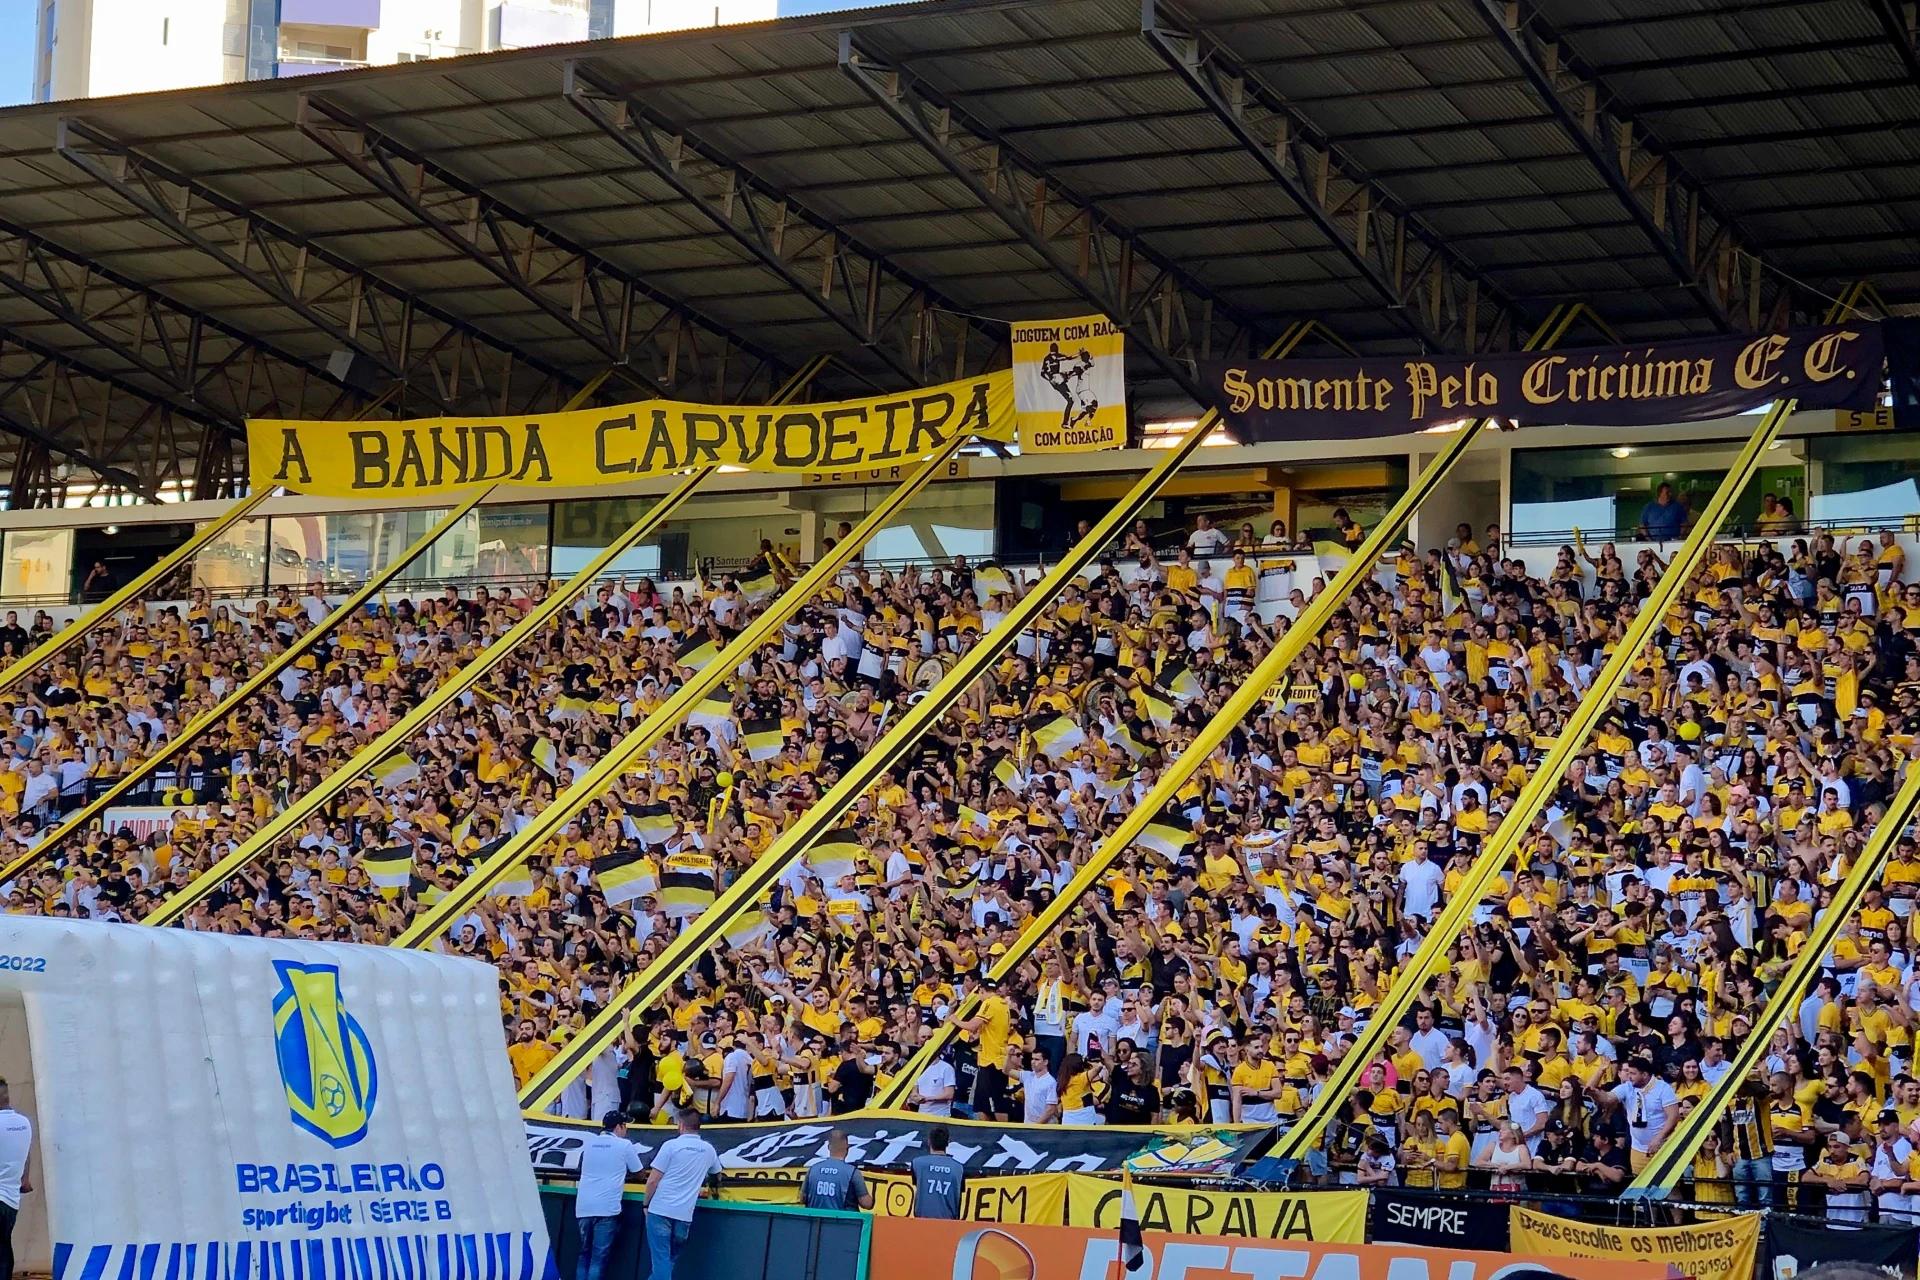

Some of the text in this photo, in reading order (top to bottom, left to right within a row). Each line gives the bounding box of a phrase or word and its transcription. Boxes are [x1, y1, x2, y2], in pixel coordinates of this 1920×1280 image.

[1013, 327, 1060, 343] JOGUEM
[1064, 324, 1090, 340] COM
[1223, 330, 1860, 421] Somente Pelo Criciúma E. C.
[273, 383, 991, 489] A BANDA CARVOEIRA
[1034, 426, 1114, 446] COM CORAÇÃO
[0, 955, 46, 972] 2022
[820, 1167, 838, 1175] FOTO
[929, 1165, 951, 1174] FOTO
[816, 1180, 836, 1197] 606
[927, 1179, 952, 1196] 747
[370, 1198, 429, 1223] SÉRIE
[435, 1200, 452, 1221] B
[1387, 1202, 1468, 1235] SEMPRE
[1519, 1211, 1560, 1240] Deus
[1563, 1227, 1623, 1251] escolhe
[1631, 1233, 1652, 1253] os
